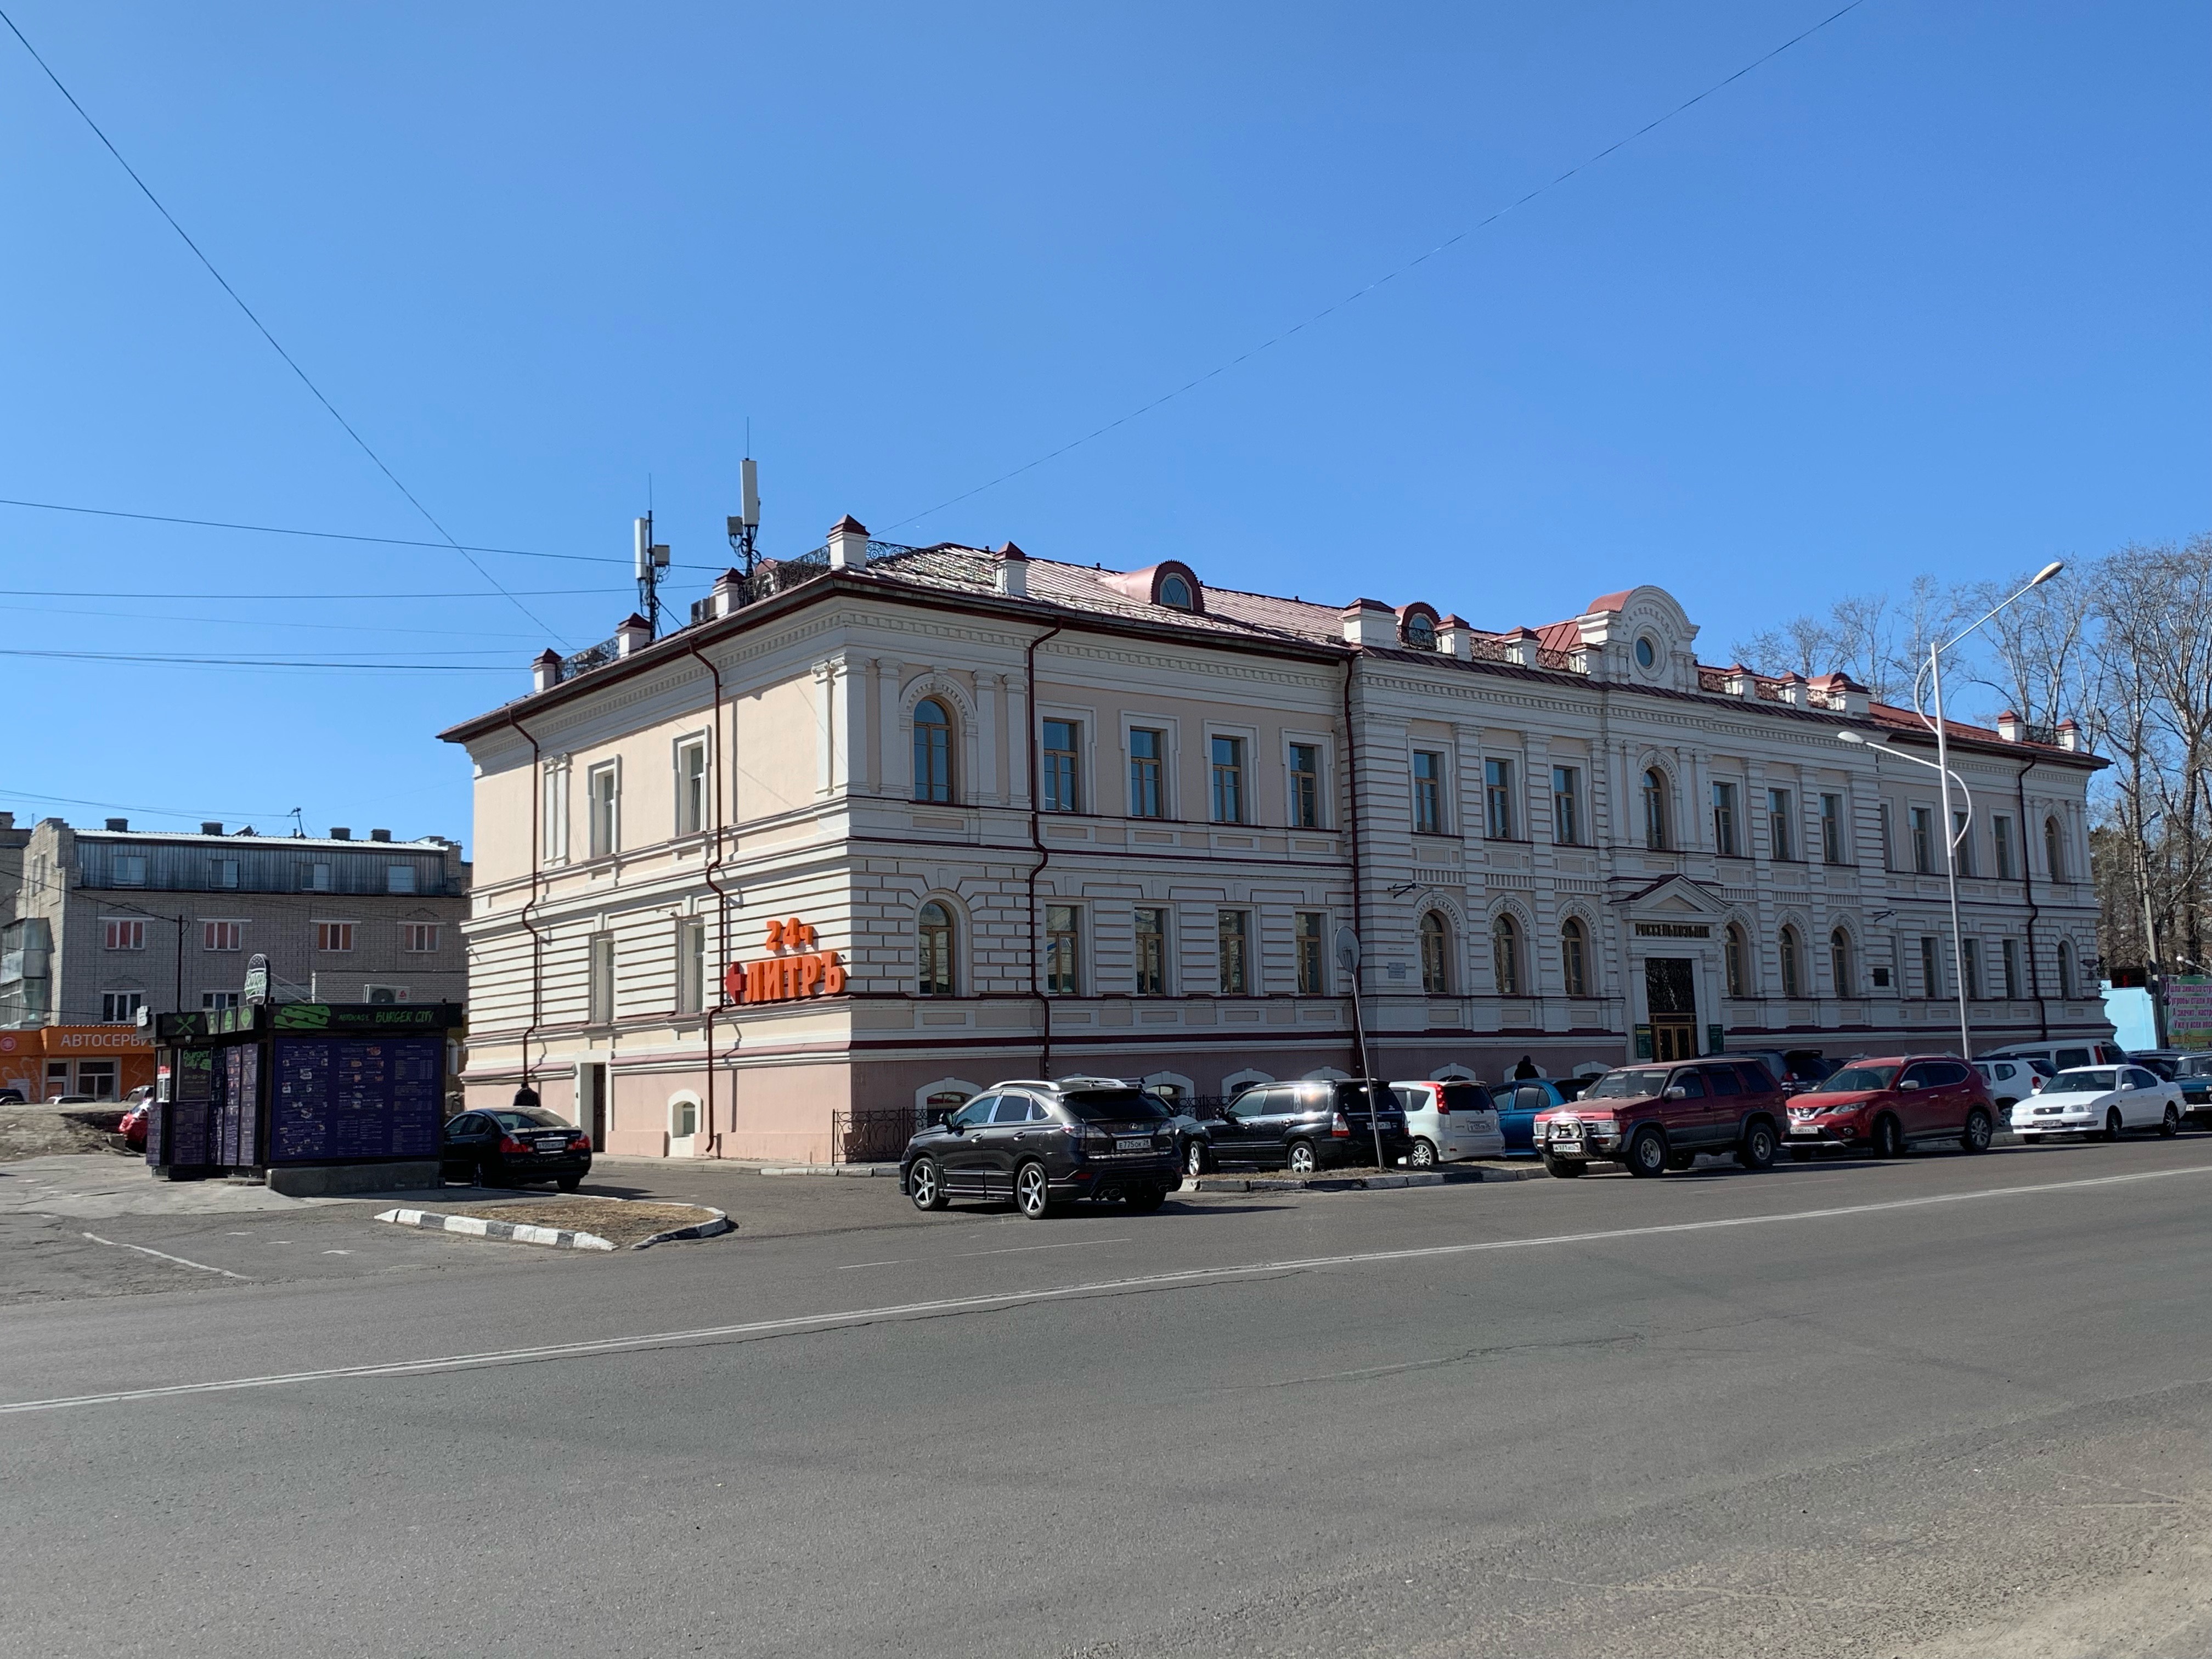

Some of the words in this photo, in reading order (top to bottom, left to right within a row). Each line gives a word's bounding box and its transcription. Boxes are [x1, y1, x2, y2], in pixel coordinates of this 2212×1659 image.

[766, 917, 814, 951] 24ч
[744, 951, 846, 1003] ЛИТРЪ
[375, 1011, 413, 1023] BURGER
[415, 1010, 434, 1023] CITY
[60, 1034, 147, 1047] АВТОСЕРВ
